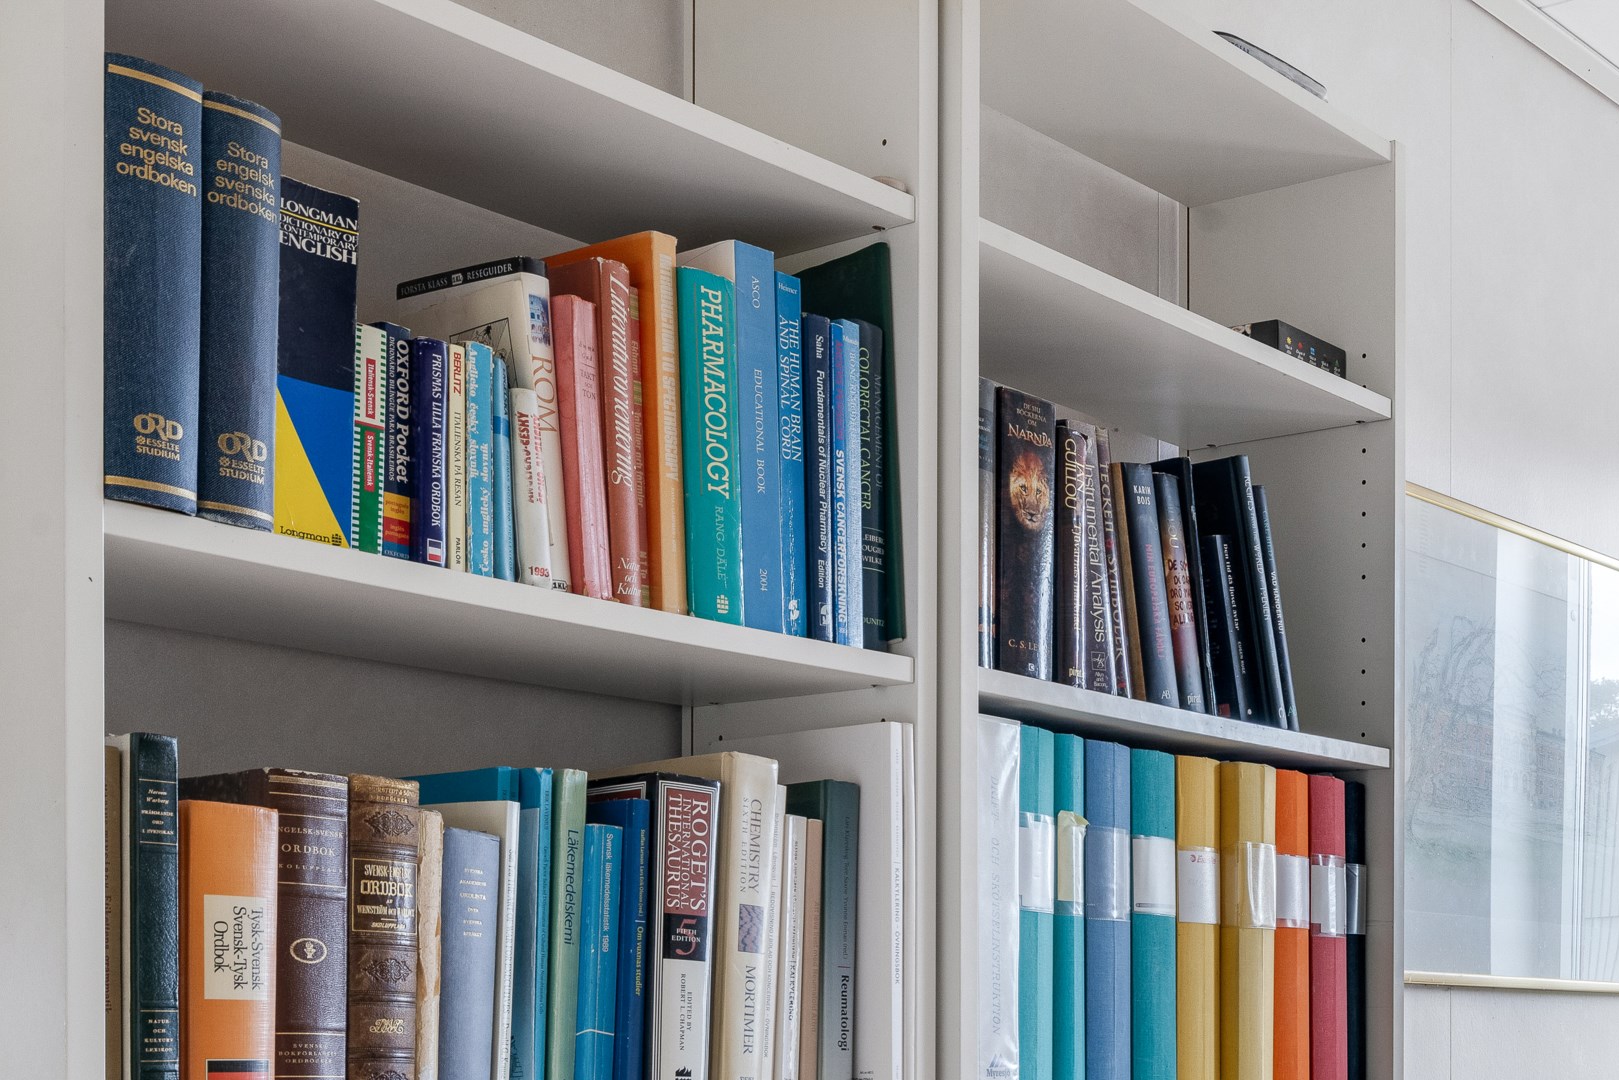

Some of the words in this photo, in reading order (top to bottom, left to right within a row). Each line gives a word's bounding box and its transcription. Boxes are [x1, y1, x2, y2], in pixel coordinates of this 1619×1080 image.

[137, 107, 183, 136] Stora
[129, 126, 188, 156] svensk
[228, 141, 269, 169] Stora
[120, 142, 194, 176] engelska
[216, 159, 275, 189] engelsk
[116, 162, 197, 197] ordboken
[215, 176, 275, 206] svenska
[207, 191, 277, 224] ordboken
[280, 197, 358, 231] LONGMAN
[280, 230, 357, 265] ENGLISH
[778, 282, 798, 295] Heimer
[815, 334, 824, 358] Saha
[432, 354, 442, 399] PRISMAS
[453, 351, 462, 397] BERLITZ
[531, 354, 558, 433] ROM
[701, 285, 730, 500] PHARMACOLOGY
[859, 347, 871, 445] COLORECTAL
[754, 368, 765, 453] EDUCATIONAL
[133, 413, 183, 442] ORD
[454, 411, 462, 459] ITALIENSKA
[1007, 423, 1053, 449] NARNIA
[136, 446, 180, 462] STUDIUM
[145, 438, 180, 453] ESSELTE
[218, 431, 267, 463] ORD
[432, 430, 442, 480] FRANSKA
[219, 467, 264, 485] STUDIUM
[232, 461, 265, 475] ESSELTE
[860, 448, 872, 510] CANCER
[1064, 438, 1077, 510] GUILLOU
[431, 481, 442, 527] ORDBOK
[454, 475, 462, 508] RESAN
[1133, 485, 1151, 495] KARIN
[1136, 495, 1151, 505] BOJS
[1084, 464, 1099, 566] Instrumental
[280, 525, 330, 544] Longman
[528, 565, 549, 578] 1993
[1090, 570, 1106, 643] Analysis
[666, 794, 682, 908] THESAURUS
[213, 920, 230, 973] Ordbok
[229, 905, 248, 990] Svensk-Tysk
[636, 926, 644, 938] Om
[635, 969, 644, 997] studier
[743, 965, 757, 1054] MORTIMER
[838, 974, 849, 1052] Reumatologi
[686, 1021, 692, 1032] BY
[986, 1068, 1011, 1078] Myresjö
